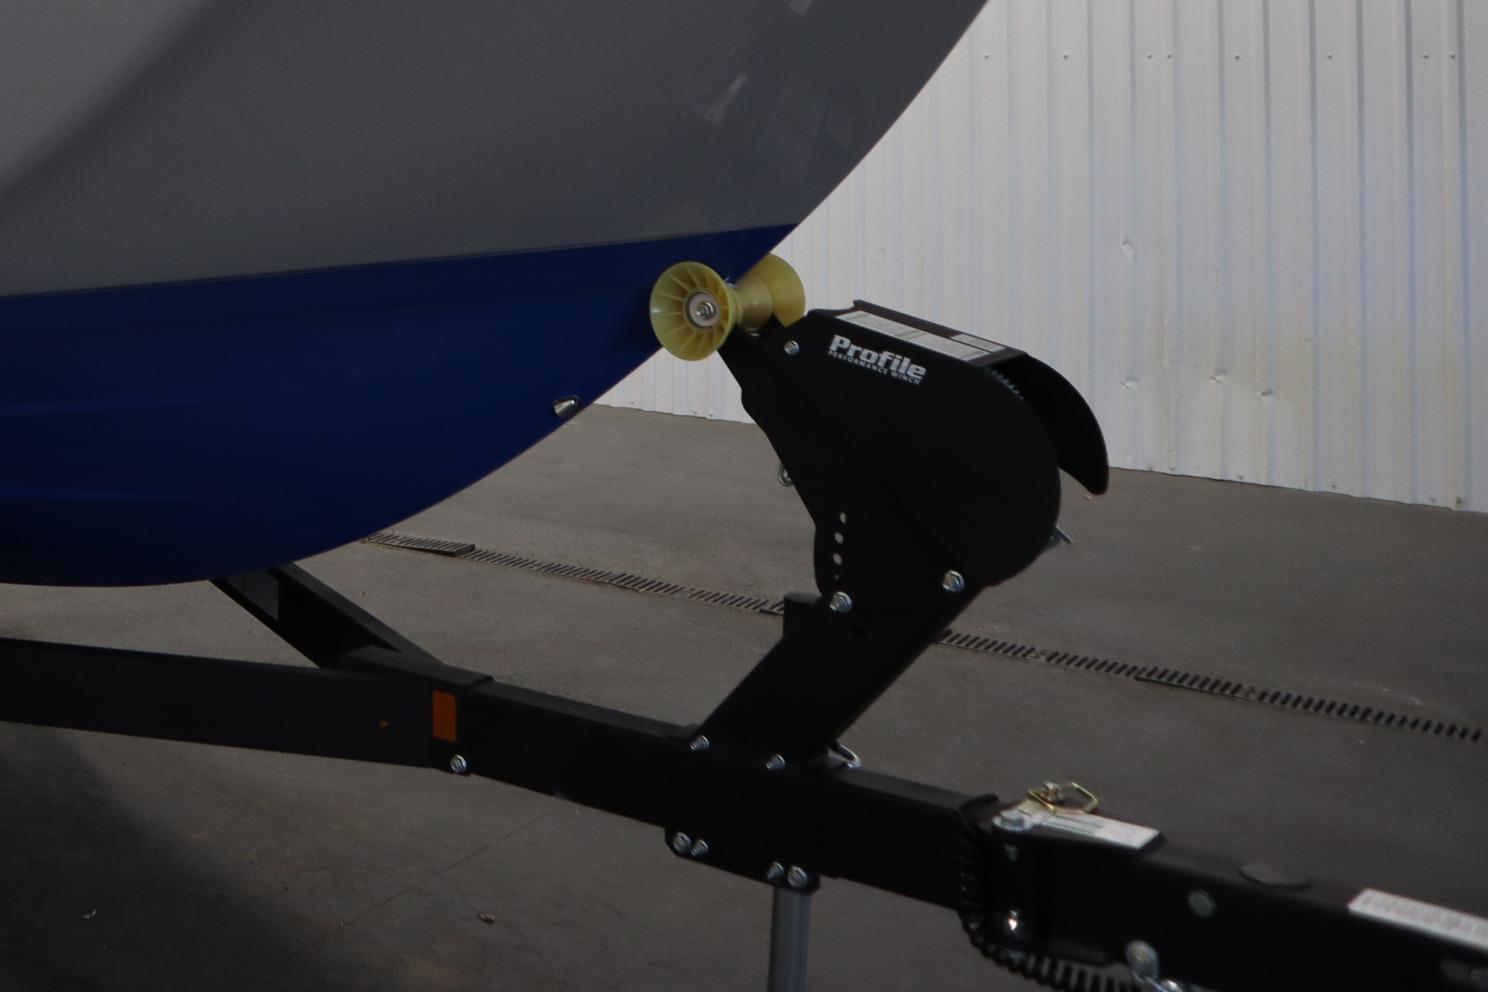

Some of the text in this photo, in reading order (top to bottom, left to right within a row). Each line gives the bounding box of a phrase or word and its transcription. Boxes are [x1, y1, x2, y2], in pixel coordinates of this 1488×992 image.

[828, 350, 921, 385] PERFORMANCE WINCH
[830, 335, 927, 379] Profile
